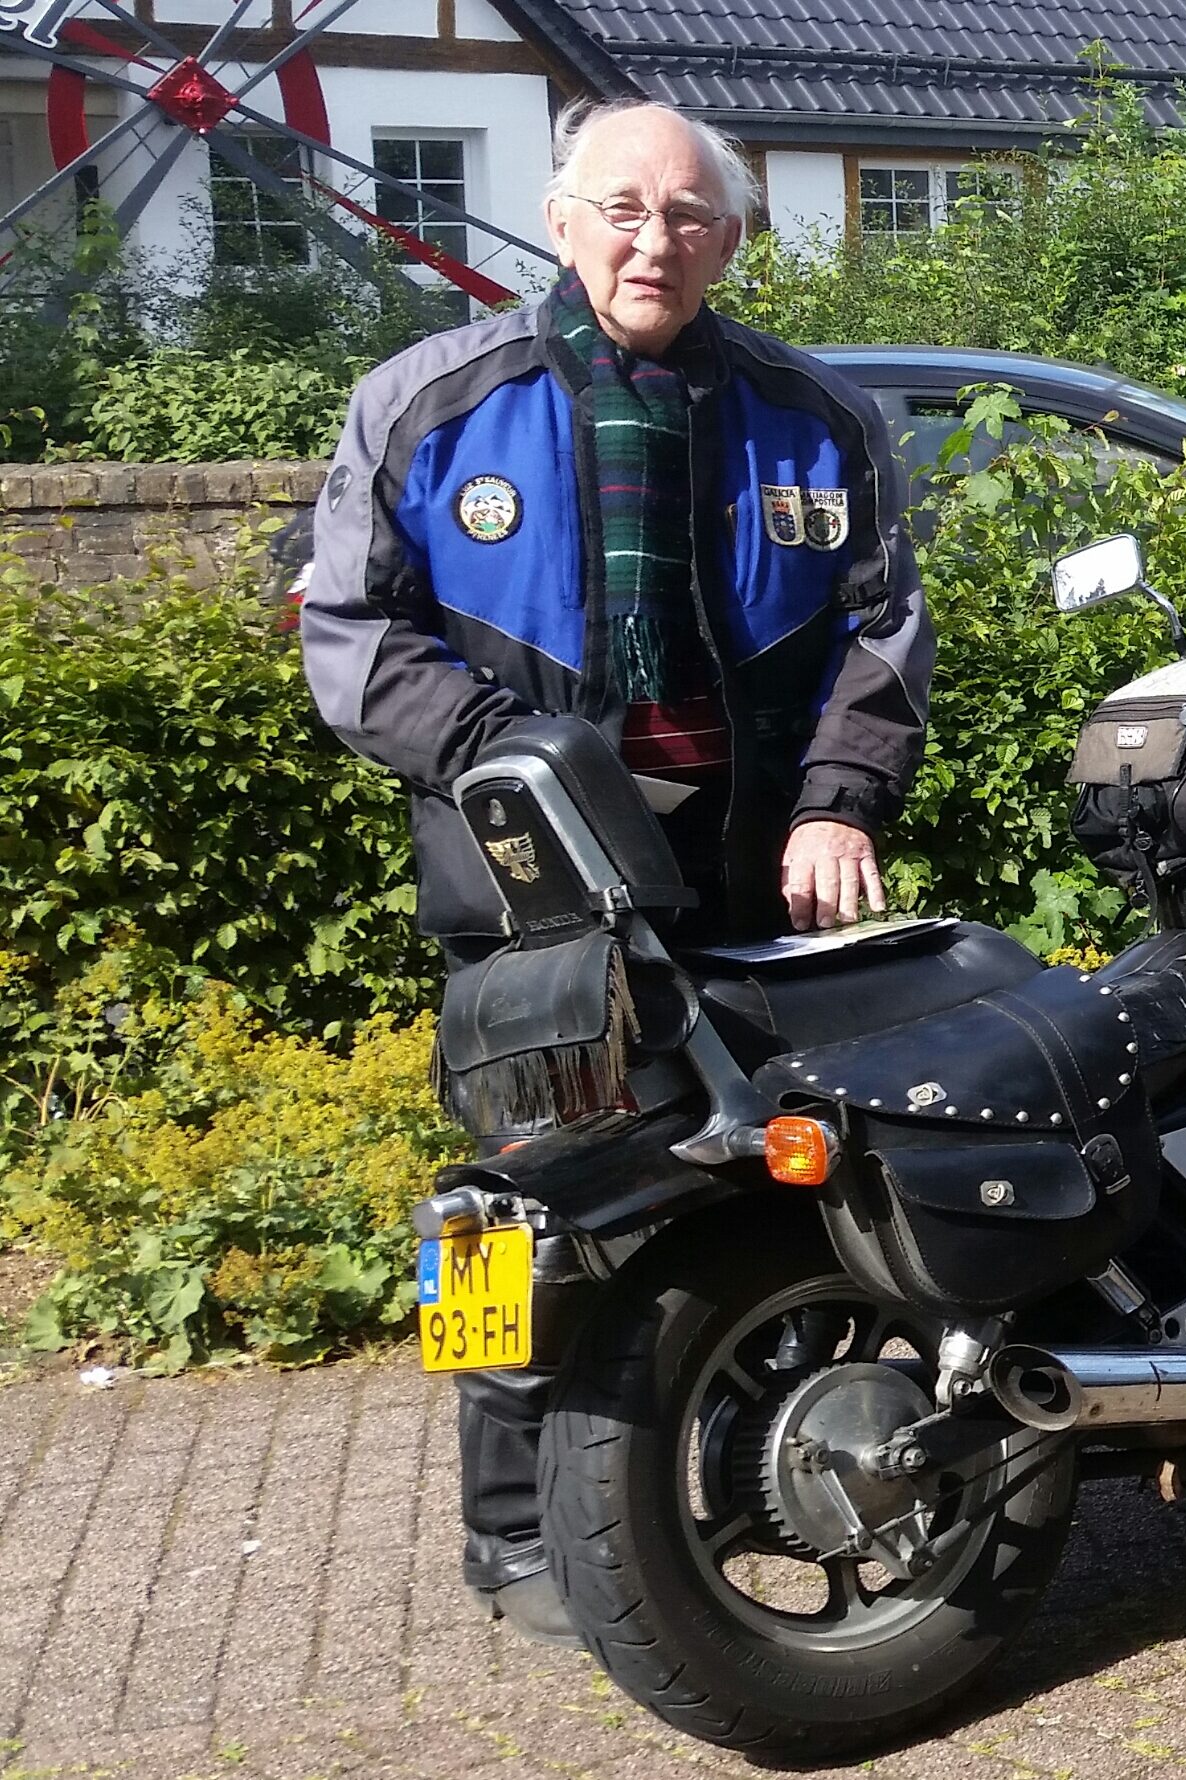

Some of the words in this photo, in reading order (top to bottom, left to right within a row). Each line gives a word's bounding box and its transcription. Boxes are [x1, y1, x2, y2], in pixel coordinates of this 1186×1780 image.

[763, 487, 796, 498] GALICIA
[451, 1241, 494, 1296] MY
[429, 1302, 520, 1361] 93-FH
